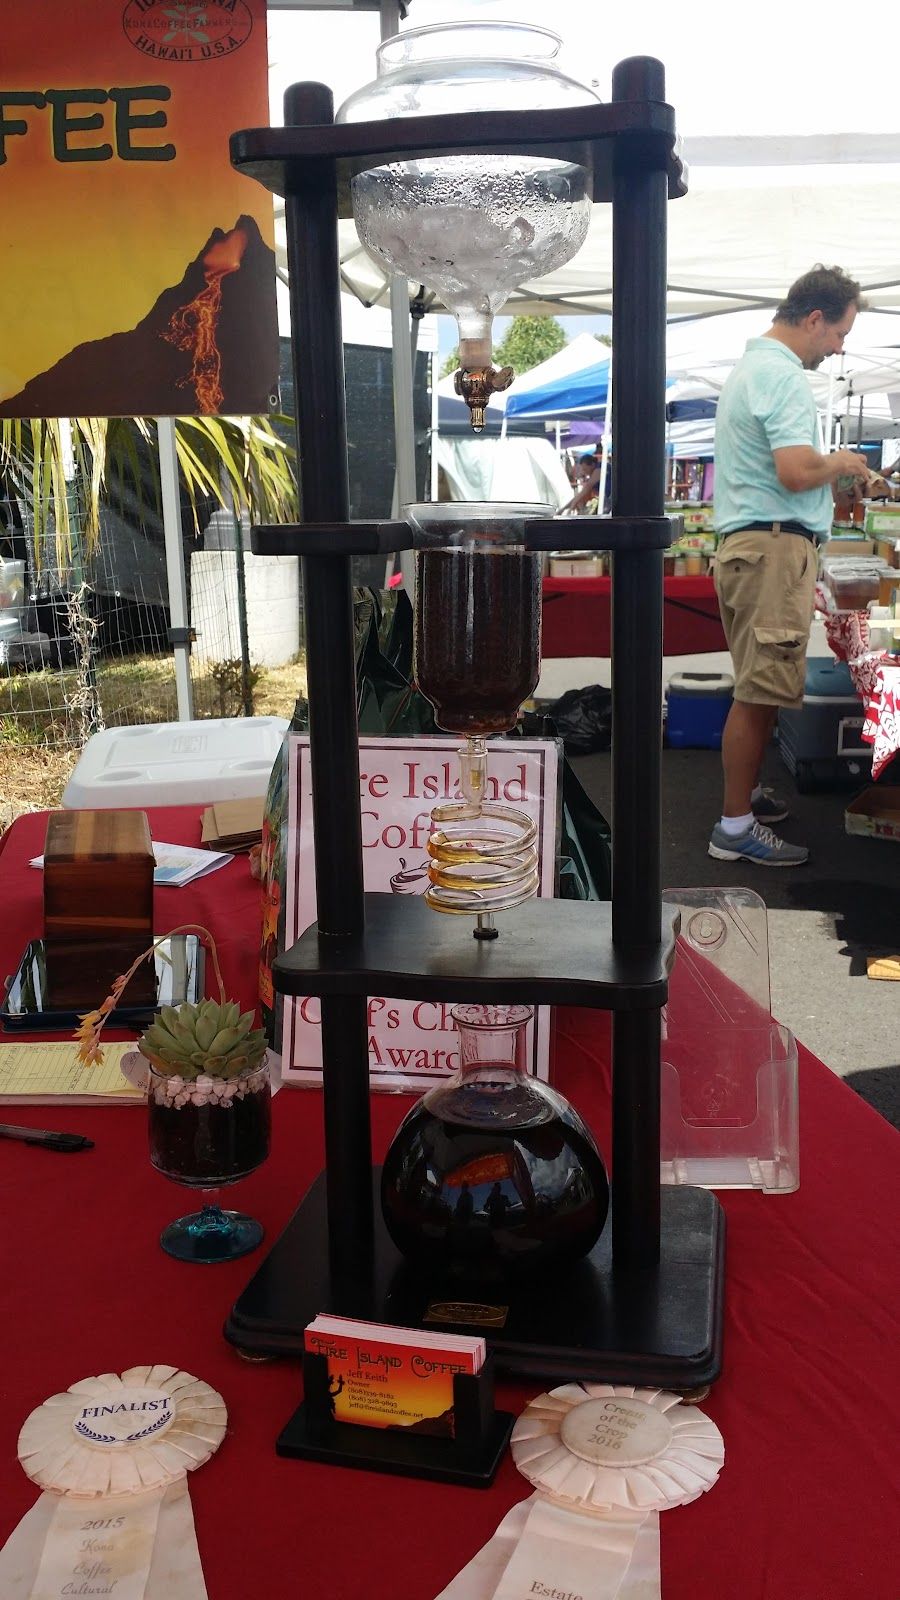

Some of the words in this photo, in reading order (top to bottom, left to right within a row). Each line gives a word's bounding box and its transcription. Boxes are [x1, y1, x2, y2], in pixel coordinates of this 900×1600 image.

[201, 36, 242, 58] U.S.A.
[300, 996, 400, 1029] Cf's
[347, 1369, 363, 1379] Jeff
[365, 1372, 388, 1383] Keith
[347, 1379, 370, 1388] Owner
[81, 1397, 172, 1418] FINALIST
[600, 1414, 618, 1423] of
[617, 1417, 638, 1430] the
[595, 1423, 629, 1440] Crop
[587, 1433, 623, 1450] 2016
[80, 1516, 127, 1531] 2015
[79, 1538, 115, 1554] Kona
[72, 1561, 113, 1579] Coffee
[61, 1580, 119, 1595] Cultural
[529, 1580, 584, 1600] Estate
